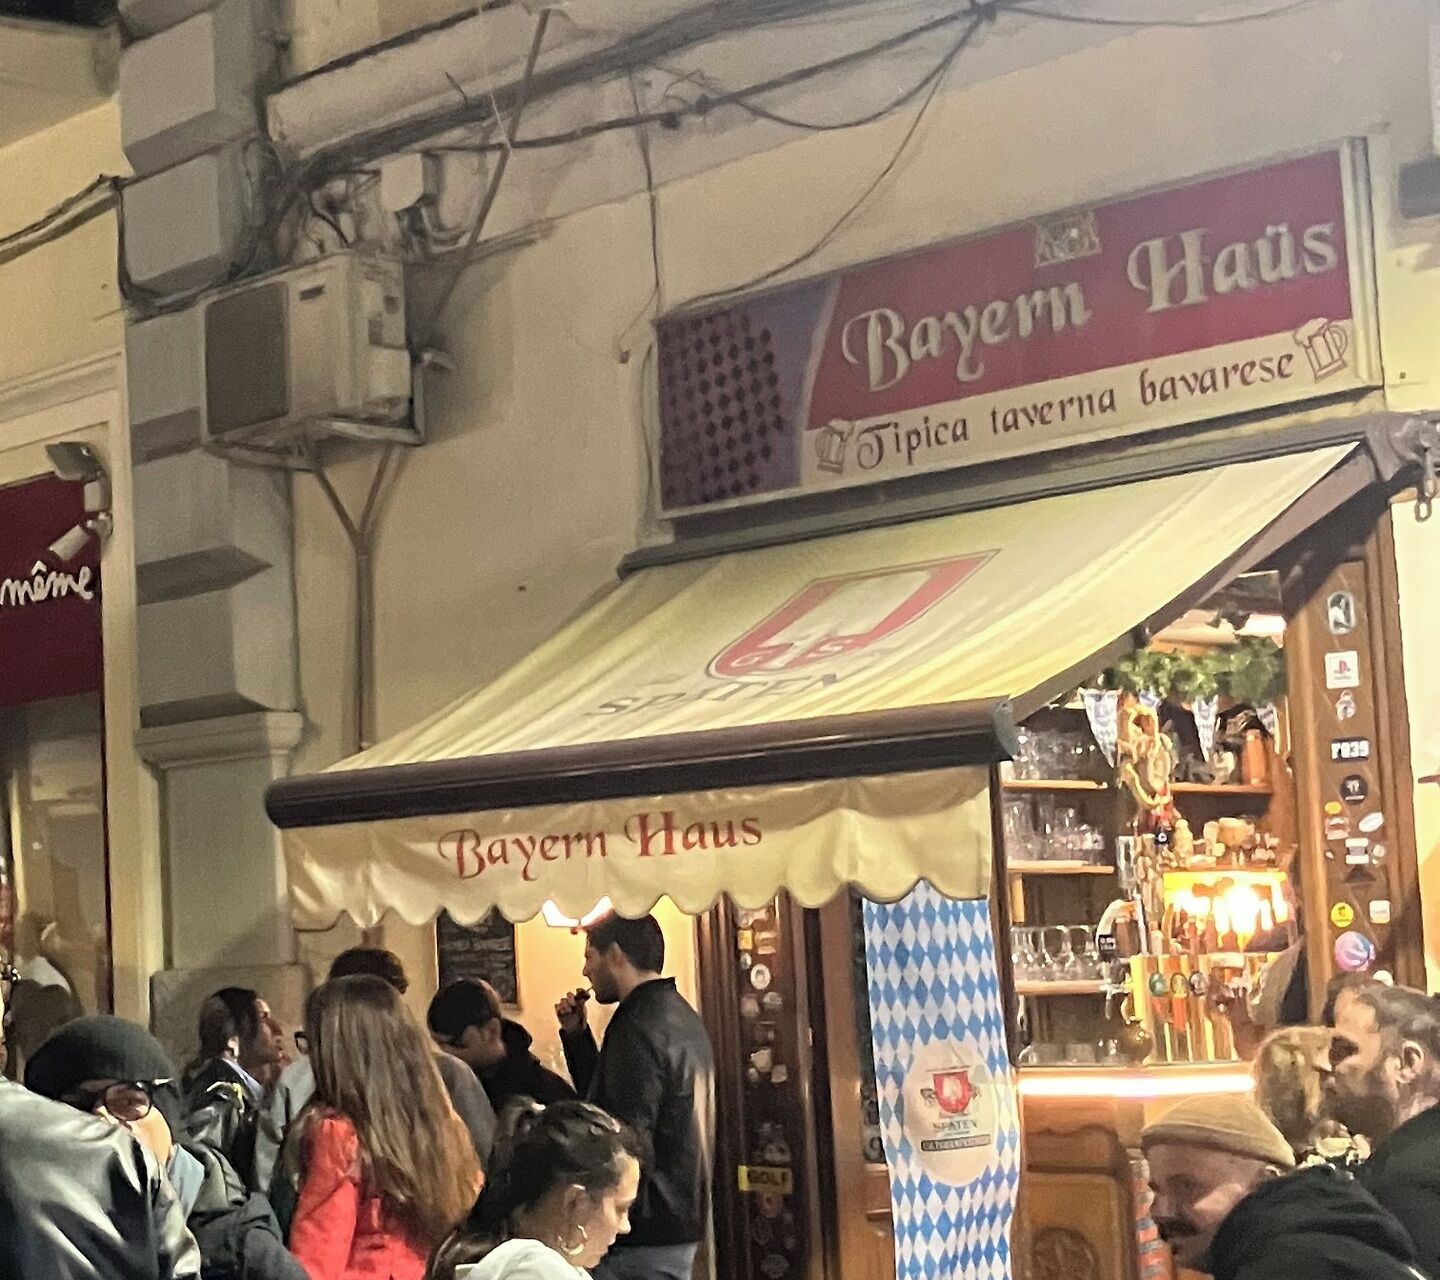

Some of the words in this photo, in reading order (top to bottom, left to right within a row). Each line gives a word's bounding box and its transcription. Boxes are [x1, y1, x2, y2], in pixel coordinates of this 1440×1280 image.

[841, 281, 1093, 392] Bayern
[856, 415, 969, 470] Tipica
[990, 387, 1117, 436] taverna
[1139, 352, 1294, 407] bavarese
[0, 559, 95, 607] même
[436, 827, 608, 882] Bayern
[623, 810, 763, 858] Haus
